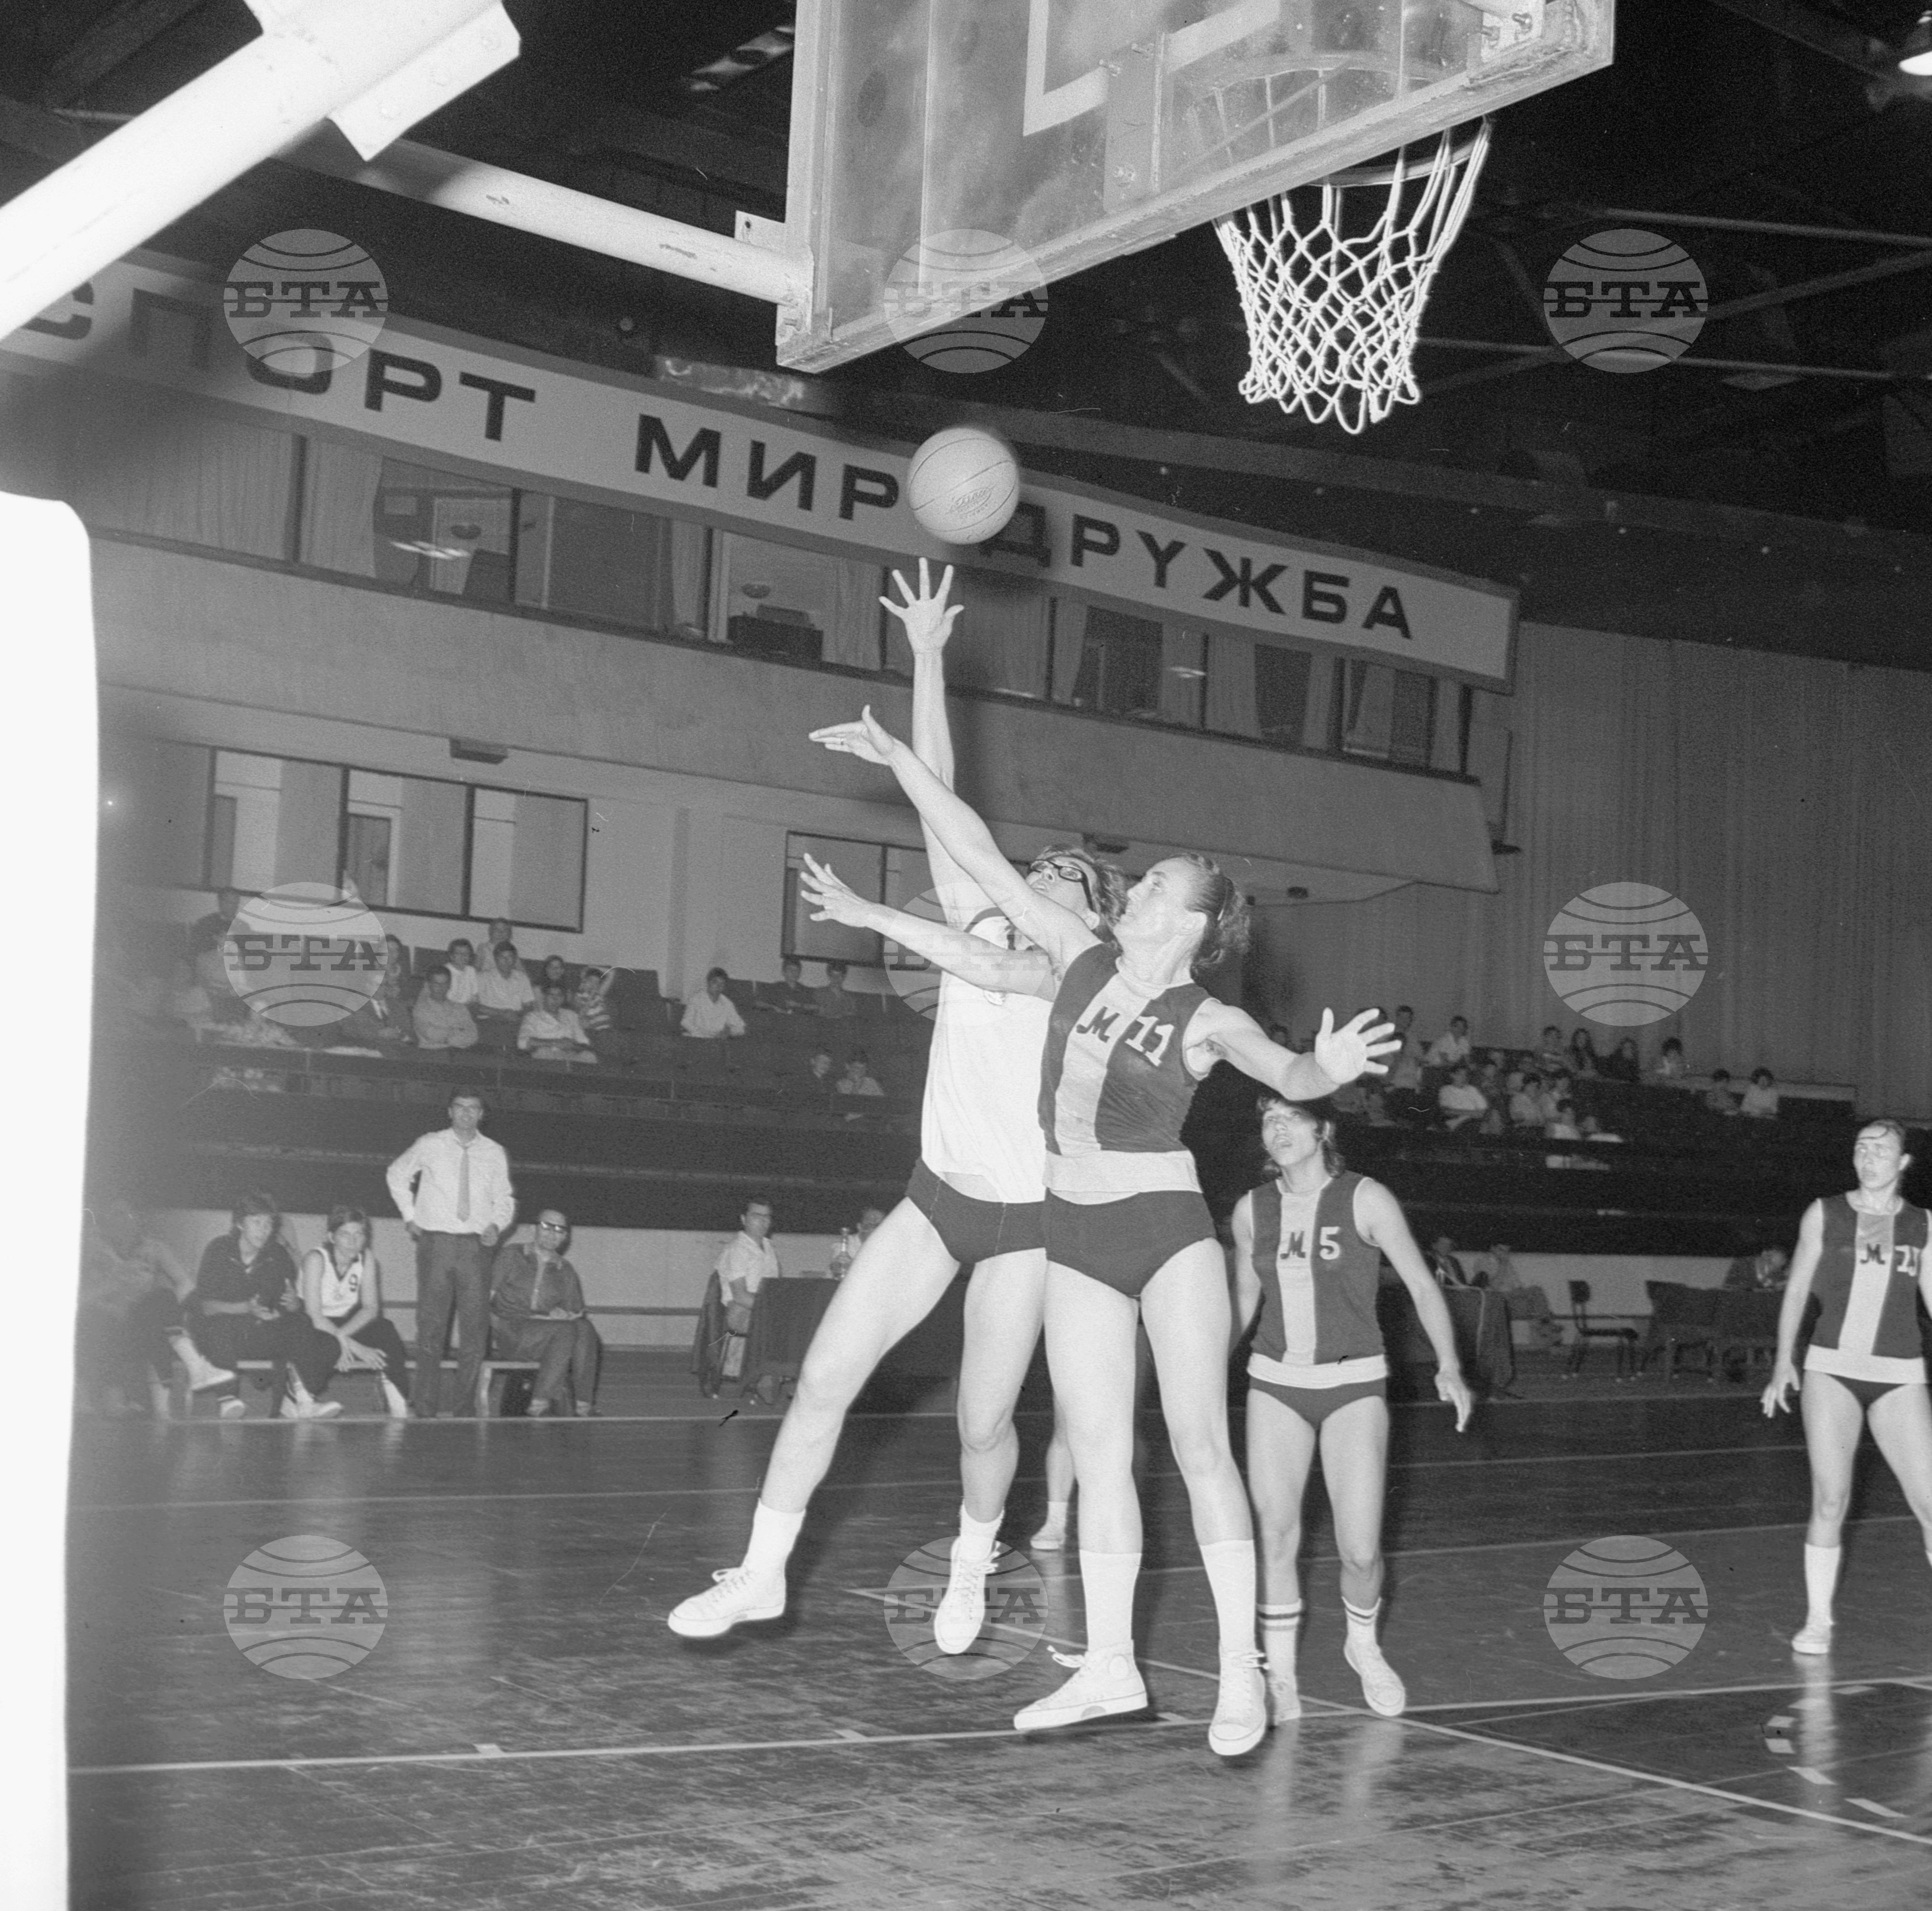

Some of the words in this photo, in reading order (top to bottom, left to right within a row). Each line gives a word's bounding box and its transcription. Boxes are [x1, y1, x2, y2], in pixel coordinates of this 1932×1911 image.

[635, 414, 900, 521] МИР
[978, 501, 1413, 640] ДРУЖБА
[1124, 1015, 1175, 1067] 11
[1319, 1226, 1341, 1260] 5
[348, 1273, 358, 1292] 9
